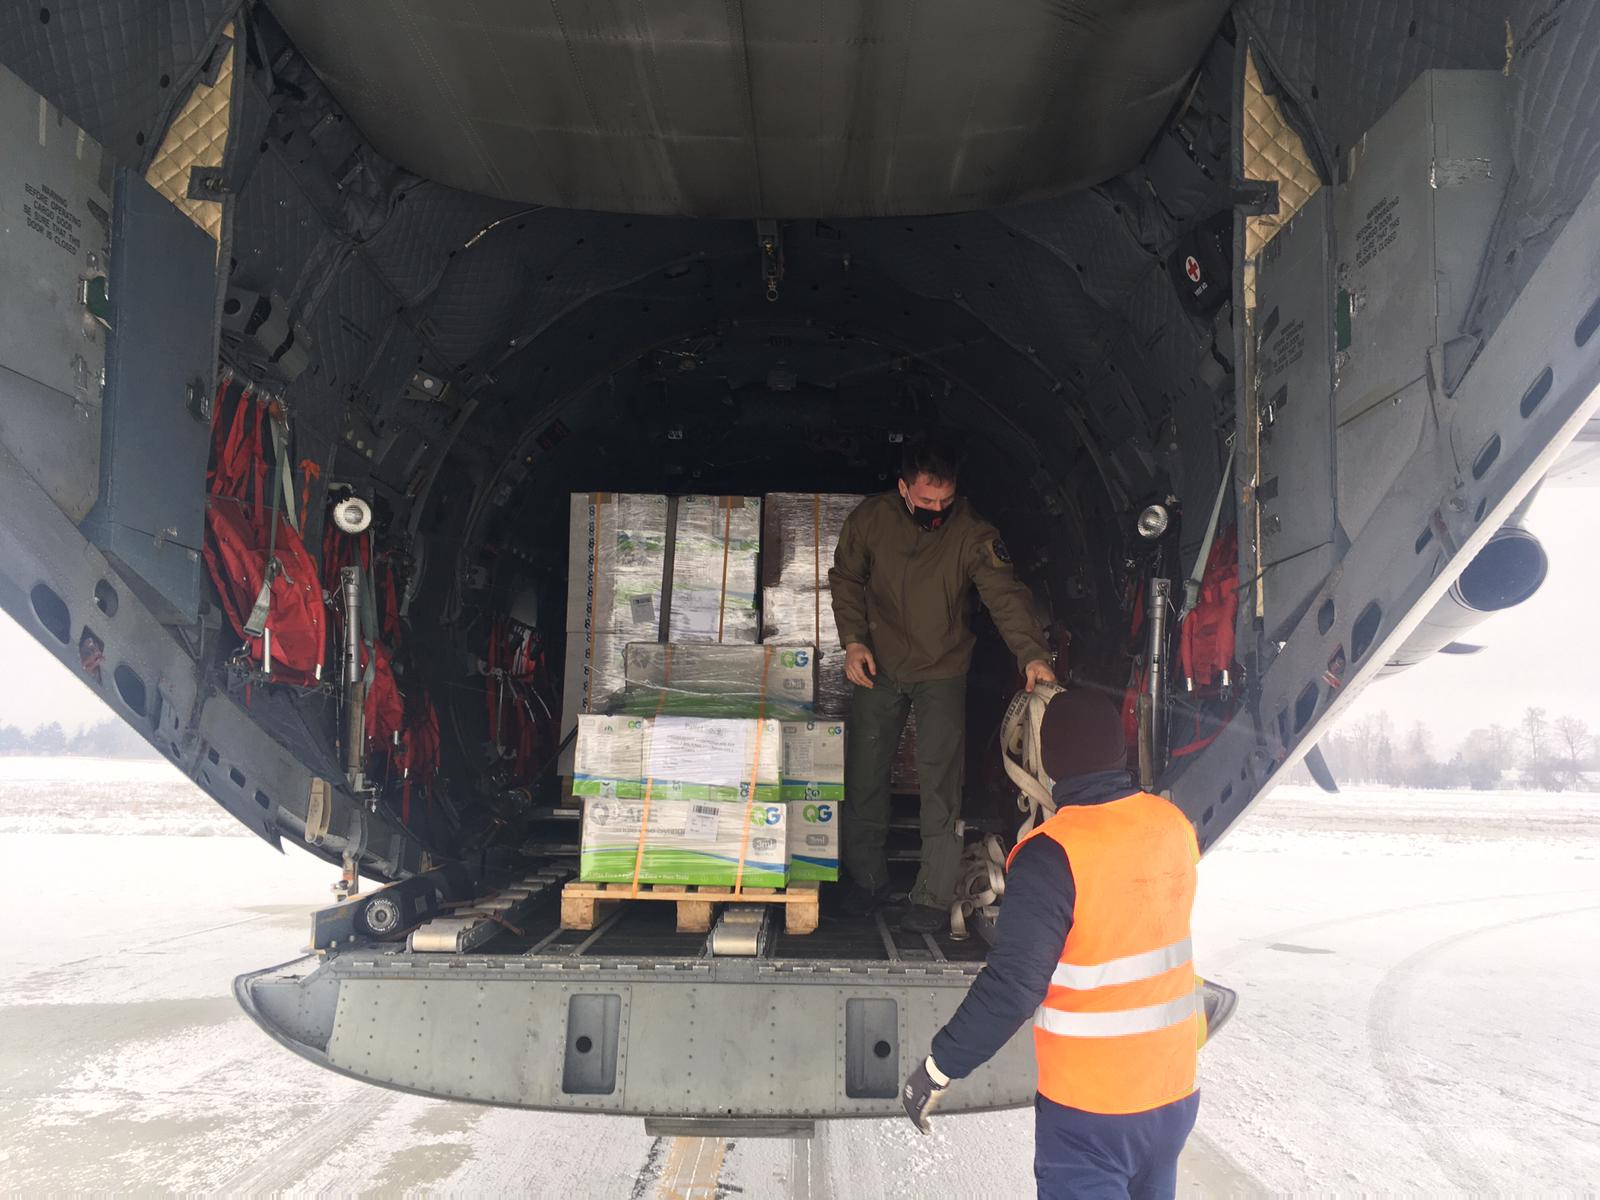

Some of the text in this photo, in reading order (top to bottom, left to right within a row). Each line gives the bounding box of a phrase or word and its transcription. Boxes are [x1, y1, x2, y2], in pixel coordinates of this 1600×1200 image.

[34, 200, 55, 220] CARGO
[780, 650, 809, 669] QG
[751, 806, 781, 827] QG
[802, 803, 833, 825] QG
